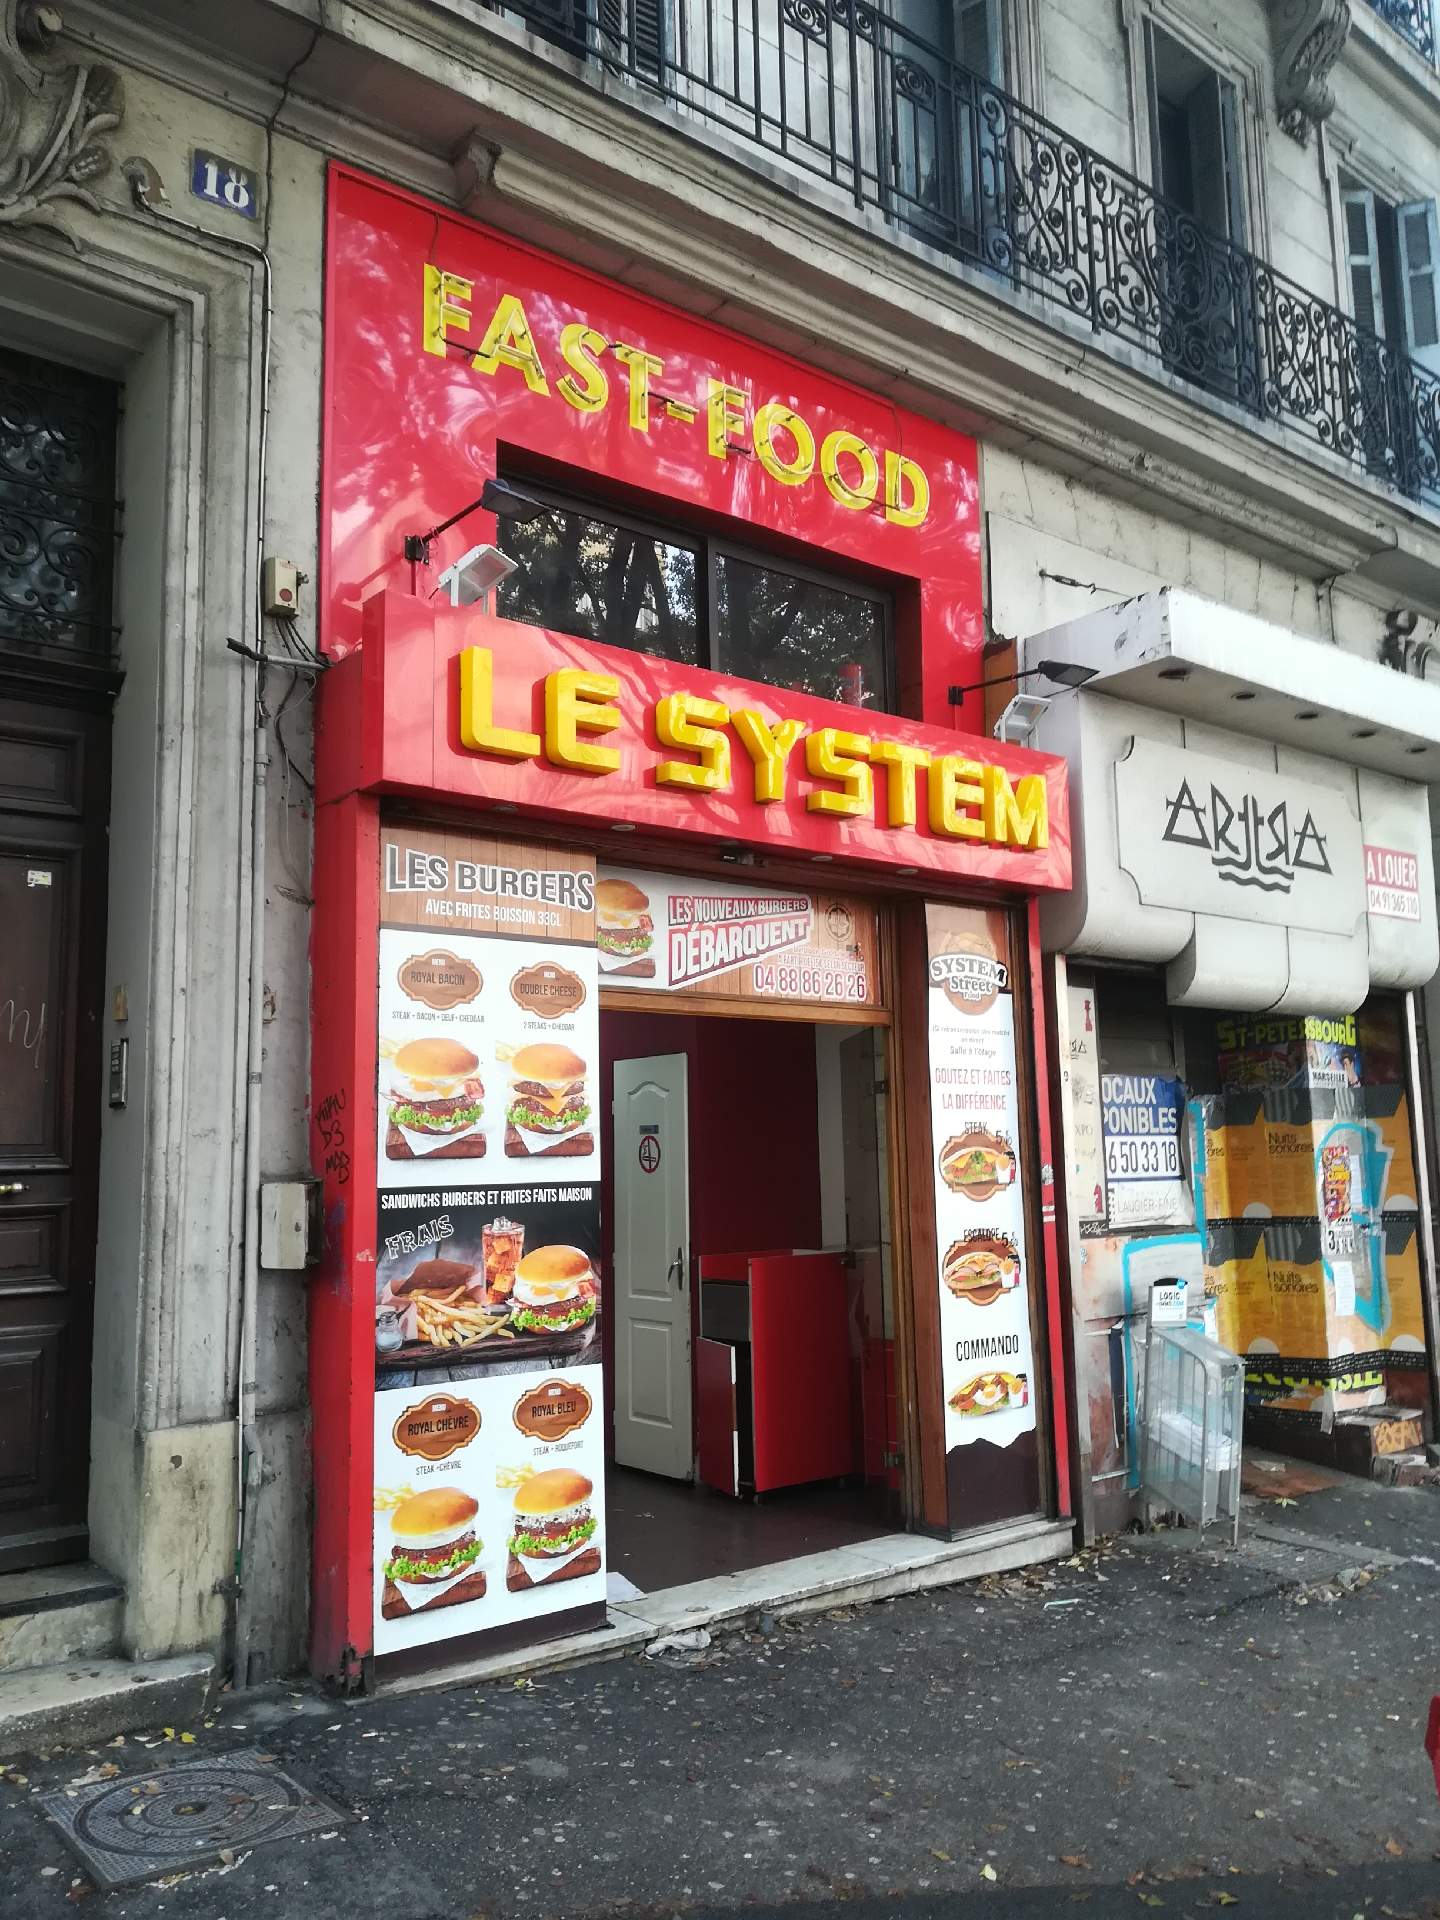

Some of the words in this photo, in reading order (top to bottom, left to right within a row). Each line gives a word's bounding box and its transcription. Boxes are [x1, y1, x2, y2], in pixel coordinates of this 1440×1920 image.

[204, 159, 249, 208] 18
[423, 263, 930, 528] FAST-FOOD
[460, 644, 621, 776] LE
[655, 692, 1049, 851] SYSTEM
[385, 843, 449, 893] LES
[455, 860, 595, 913] BURGERS
[1367, 851, 1376, 882] A
[1377, 852, 1417, 889] LOUER
[426, 898, 453, 917] AVEC
[455, 901, 490, 920] FRITES
[493, 906, 536, 925] BOISSON
[537, 911, 561, 927] 33CL
[669, 897, 692, 925] LES
[693, 897, 757, 922] NOUVEAUX
[757, 899, 808, 916] BURGERS
[671, 917, 809, 984] DÉBARQUENT
[411, 971, 436, 984] ROYAL
[438, 973, 465, 986] BACON
[754, 965, 775, 991] 04
[779, 967, 798, 993] 88
[802, 969, 821, 994] 86
[825, 972, 844, 996] 26
[848, 974, 865, 999] 26
[931, 956, 1006, 984] SYSTEM
[951, 975, 993, 993] Street
[520, 983, 549, 996] DOUBLE
[550, 985, 577, 998] CHEESE
[970, 1068, 981, 1085] ET
[983, 1069, 1011, 1087] FAITES
[942, 1092, 955, 1110] LA
[956, 1090, 1007, 1111] DIFFÉRENCE
[964, 1121, 988, 1135] STEAK
[1121, 1141, 1139, 1174] 50
[1141, 1141, 1159, 1173] 33
[1163, 1140, 1178, 1173] 18
[381, 1193, 441, 1210] SANDWICHS
[442, 1190, 486, 1208] BURGERS
[487, 1190, 499, 1205] ET
[500, 1189, 532, 1206] FRITES
[532, 1188, 558, 1204] FAITS
[558, 1187, 593, 1202] MAISON
[385, 1214, 455, 1260] FRAIS
[1159, 1291, 1181, 1301] LOGIC
[956, 1334, 1019, 1362] COMMANDO
[531, 1404, 556, 1418] ROYAL
[557, 1400, 577, 1414] BLEU
[408, 1420, 435, 1436] ROYAL
